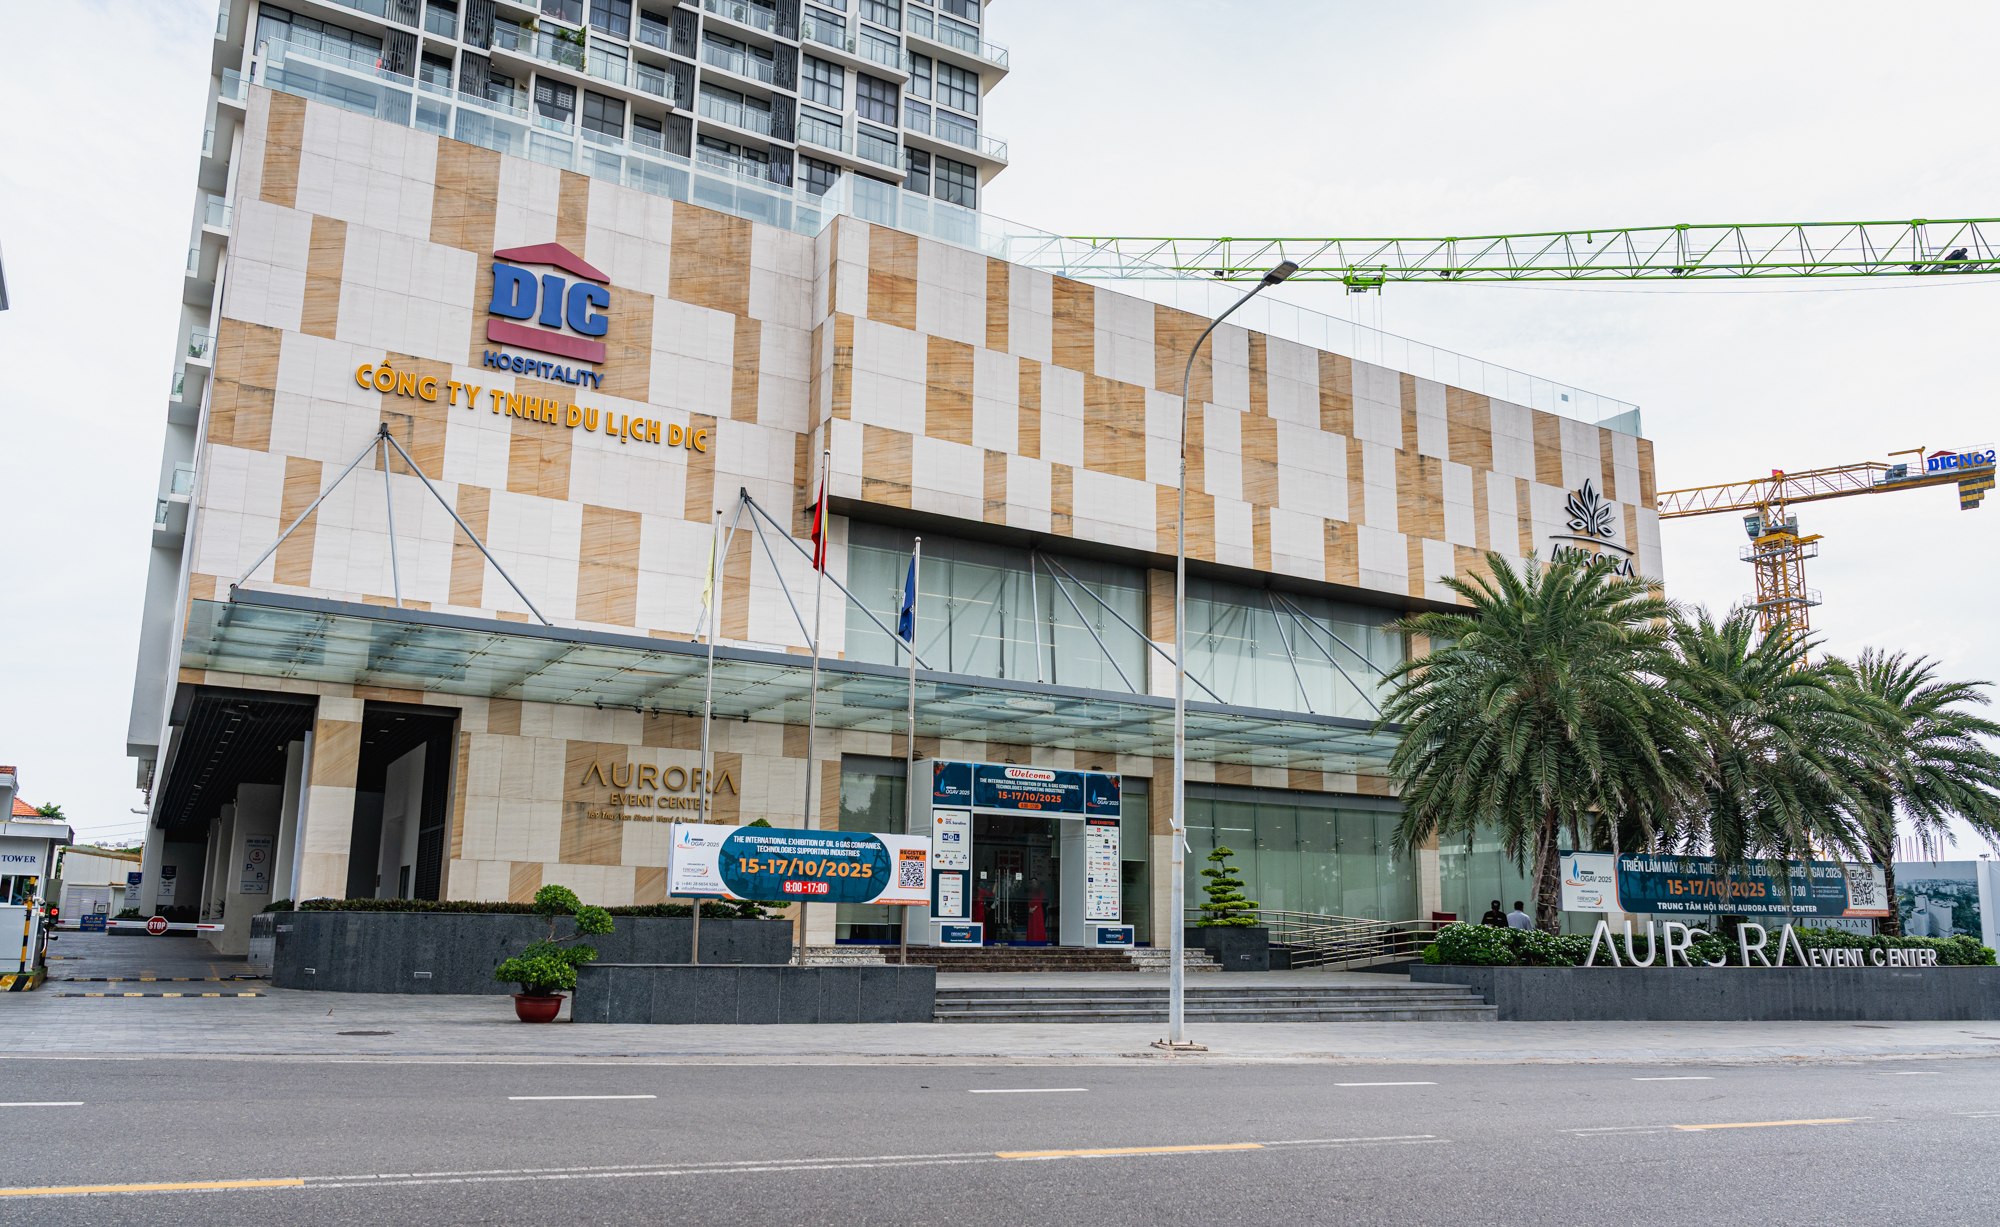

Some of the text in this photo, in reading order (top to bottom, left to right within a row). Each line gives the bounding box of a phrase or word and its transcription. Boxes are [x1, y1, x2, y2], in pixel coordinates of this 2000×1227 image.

[489, 262, 610, 336] DIC
[484, 350, 604, 388] HOSPITALITY
[355, 359, 707, 452] CÔNG TY TNHH DU LỊCH DIC
[582, 760, 738, 794] AURORA
[1009, 769, 1051, 780] Welcome
[611, 793, 710, 810] EVENT CENTER
[998, 791, 1061, 803] 15-17/10/2025
[602, 812, 617, 821] Thuy
[656, 815, 673, 823] Ward
[733, 835, 744, 843] THE
[745, 836, 787, 845] INTERNATIONAL
[788, 838, 818, 846] EXHIBITION
[851, 842, 882, 850] COMPANIES,
[757, 845, 860, 857] TECHNOLOGIES SUPPORTING INDUSTRIES
[2, 855, 36, 863] TOWER
[739, 858, 873, 878] 15-17/10/2025
[1621, 856, 1644, 872] TRIỂN
[1644, 859, 1660, 873] LÃM
[1662, 860, 1678, 874] MÁY
[1825, 867, 1841, 878] 2025
[785, 881, 802, 893] 9:00
[1657, 902, 1683, 910] TRUNG
[1685, 901, 1701, 911] TÂM
[1703, 902, 1716, 913] HỘI
[1718, 903, 1736, 913] NGHỊ
[1738, 904, 1767, 912] AURORA
[149, 921, 166, 930] STOP
[1810, 918, 1868, 929] DIC STAR
[1809, 948, 1865, 967] EVENT
[1870, 948, 1939, 967] CENTER
